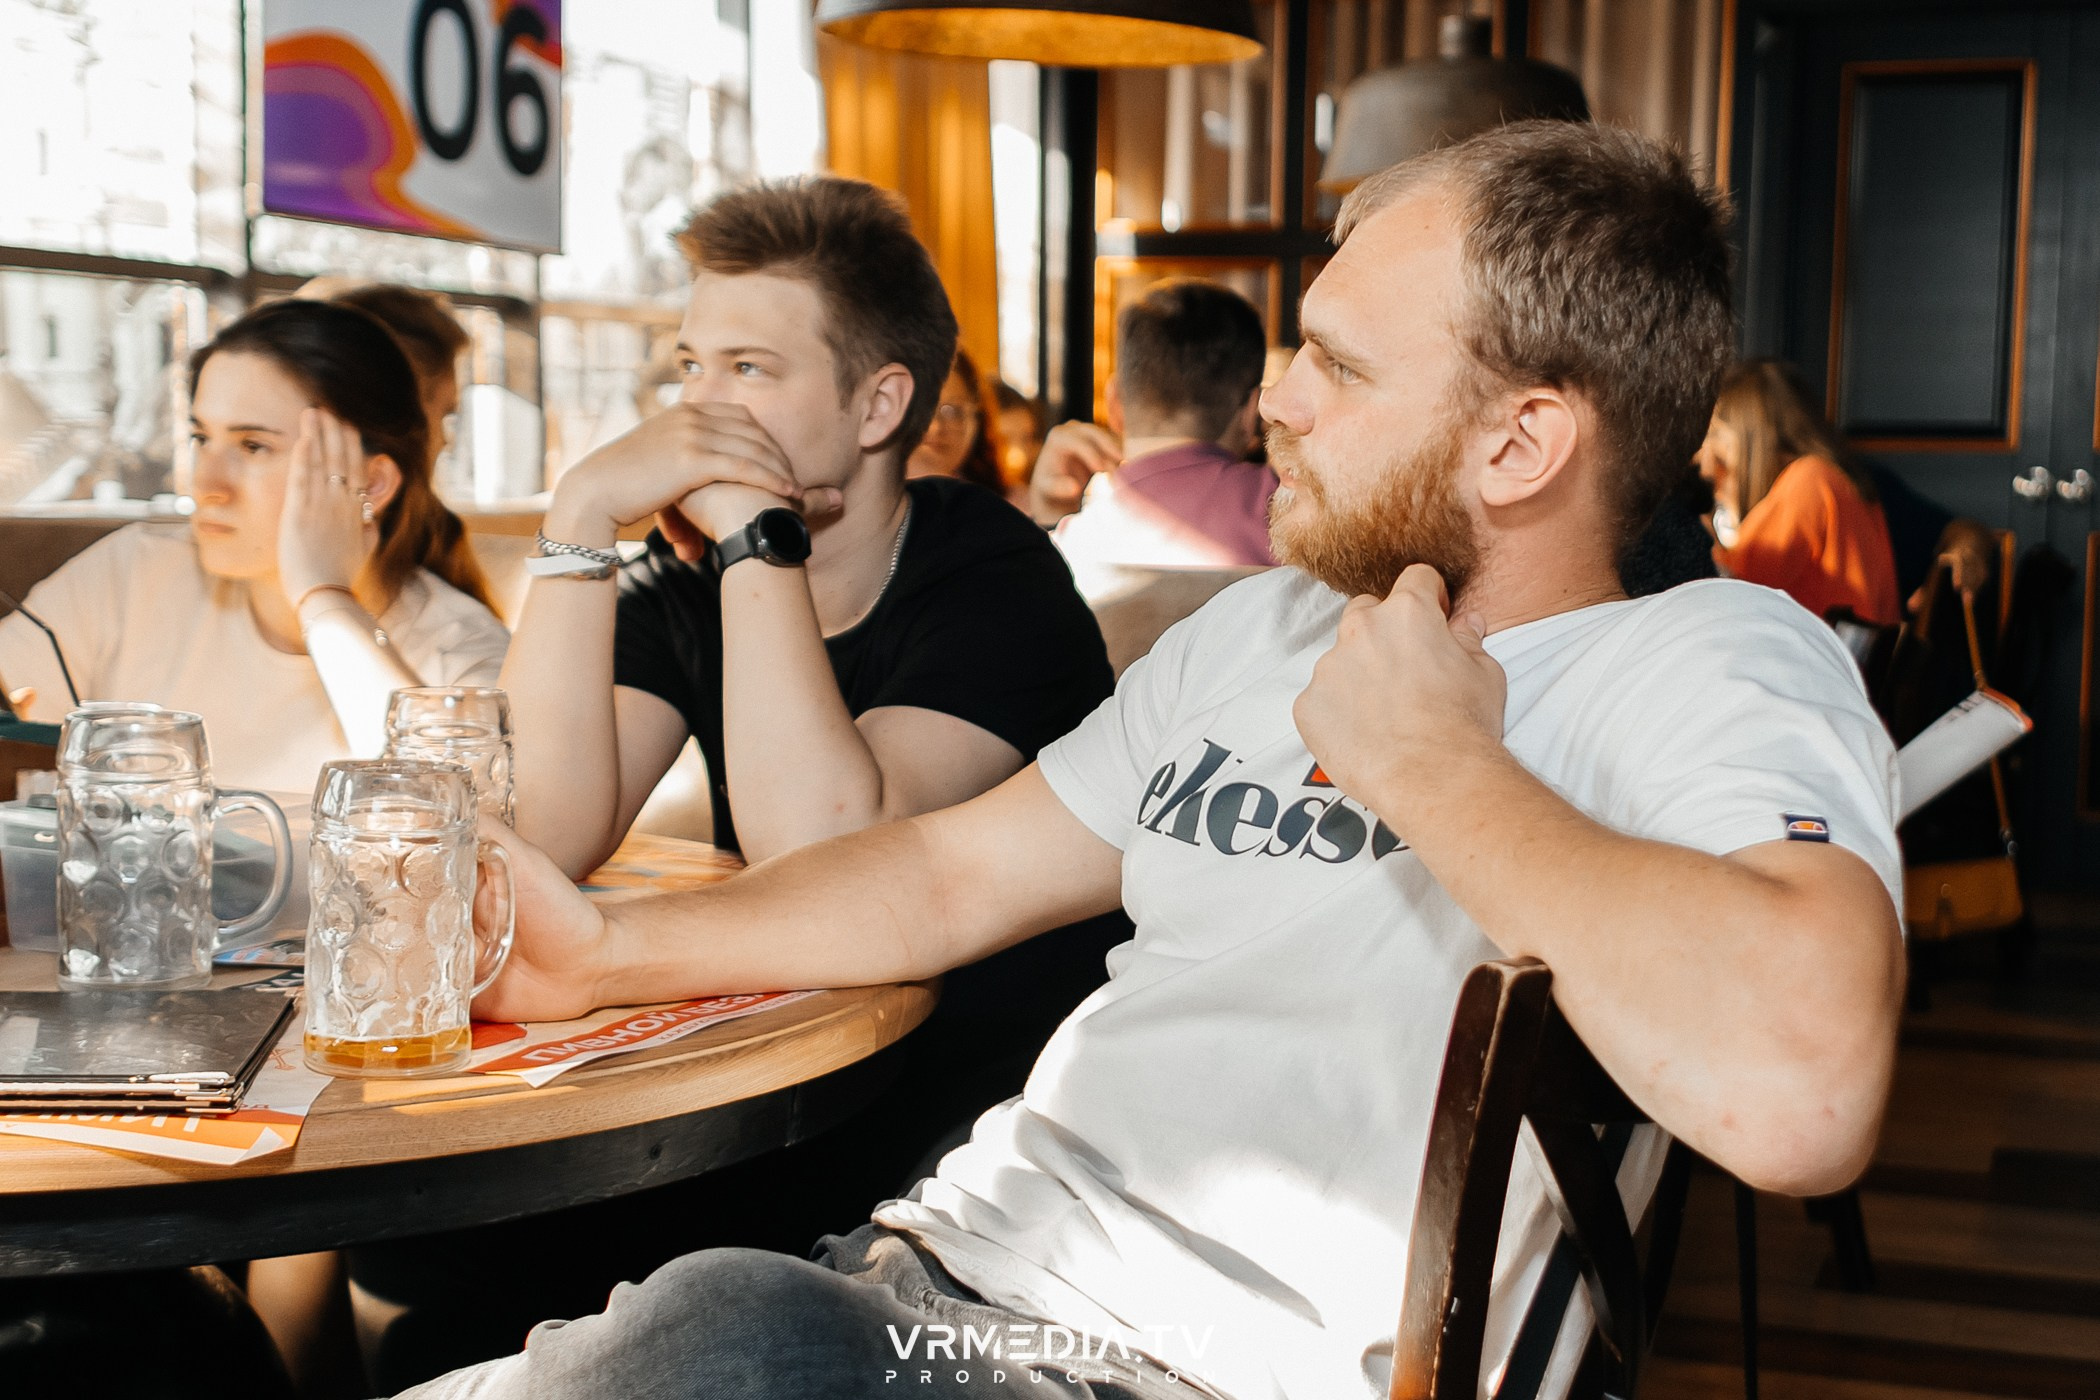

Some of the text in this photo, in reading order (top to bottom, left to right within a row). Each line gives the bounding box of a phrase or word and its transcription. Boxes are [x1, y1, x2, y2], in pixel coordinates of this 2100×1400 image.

[409, 0, 549, 176] 06
[521, 1011, 691, 1062] ПИВНОЙ
[685, 993, 765, 1015] БЕЗ
